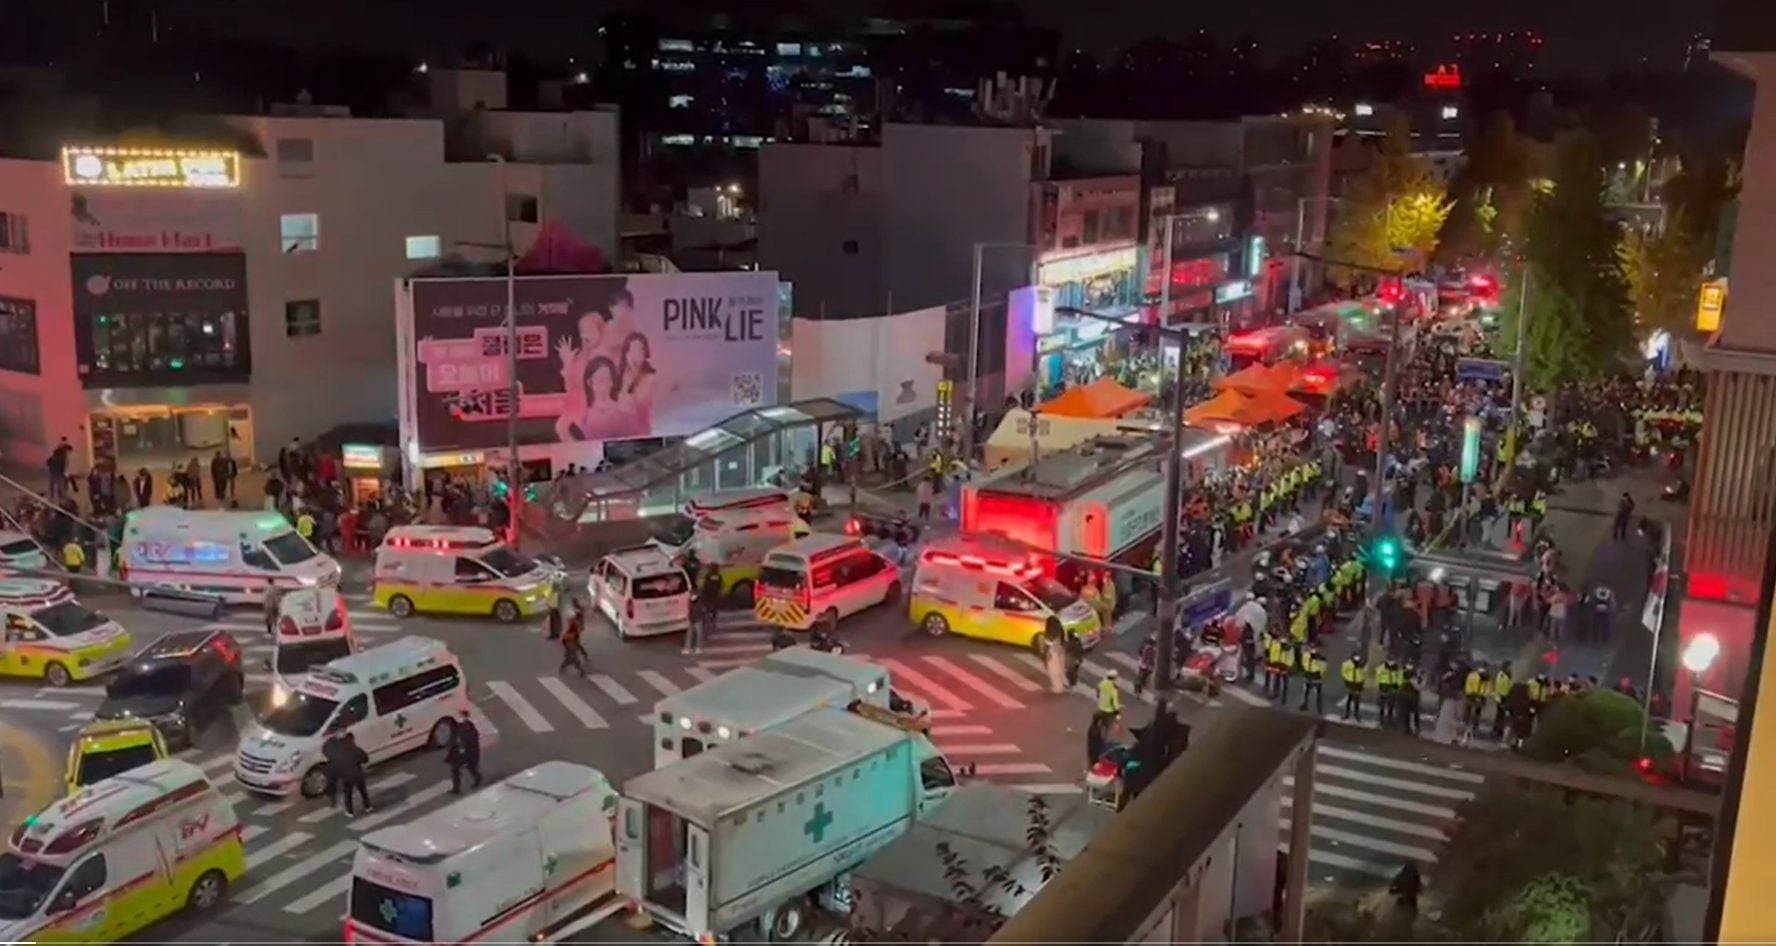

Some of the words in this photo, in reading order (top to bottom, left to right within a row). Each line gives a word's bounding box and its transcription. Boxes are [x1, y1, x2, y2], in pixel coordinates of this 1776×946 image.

[113, 278, 137, 290] OFF
[144, 278, 171, 290] THE
[175, 277, 236, 290] RECORD
[664, 297, 723, 331] PINK
[725, 309, 763, 341] LIE
